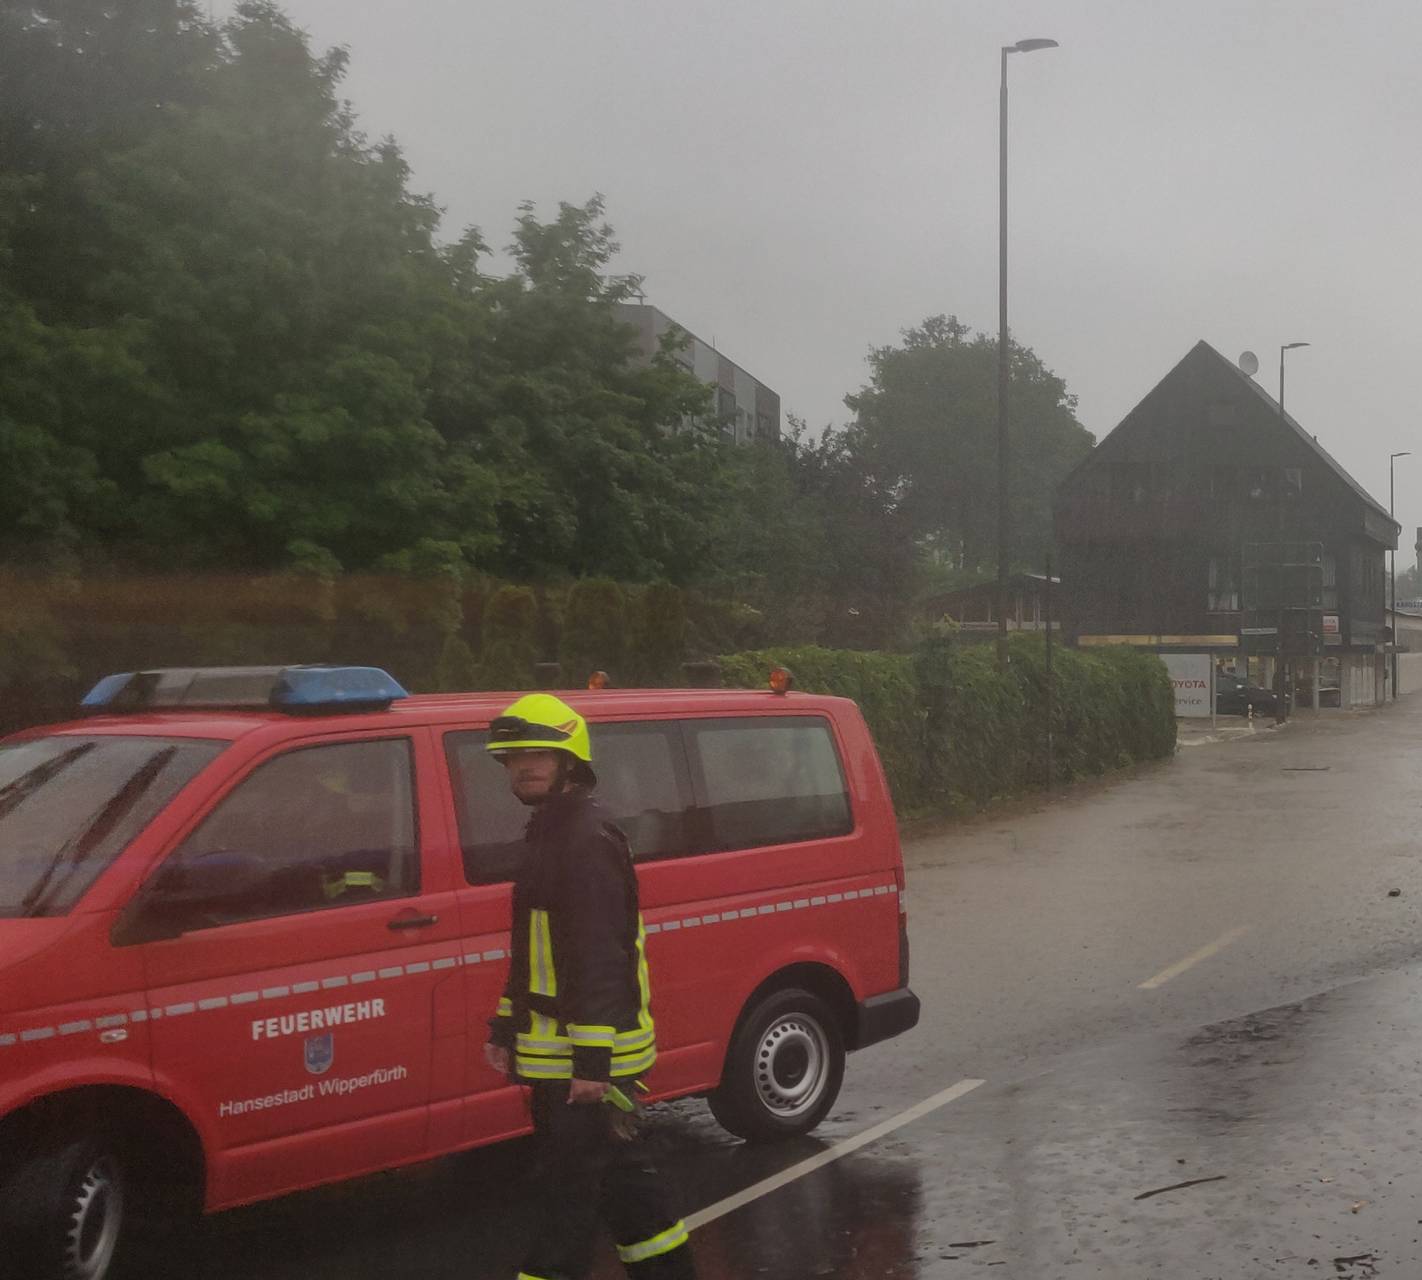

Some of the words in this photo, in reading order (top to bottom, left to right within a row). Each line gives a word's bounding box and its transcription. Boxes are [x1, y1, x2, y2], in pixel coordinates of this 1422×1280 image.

[1168, 680, 1207, 688] OYOTA
[252, 998, 385, 1040] FEUERWEHR
[219, 1085, 314, 1117] Hansestadt
[318, 1065, 407, 1095] Wipperfürth
